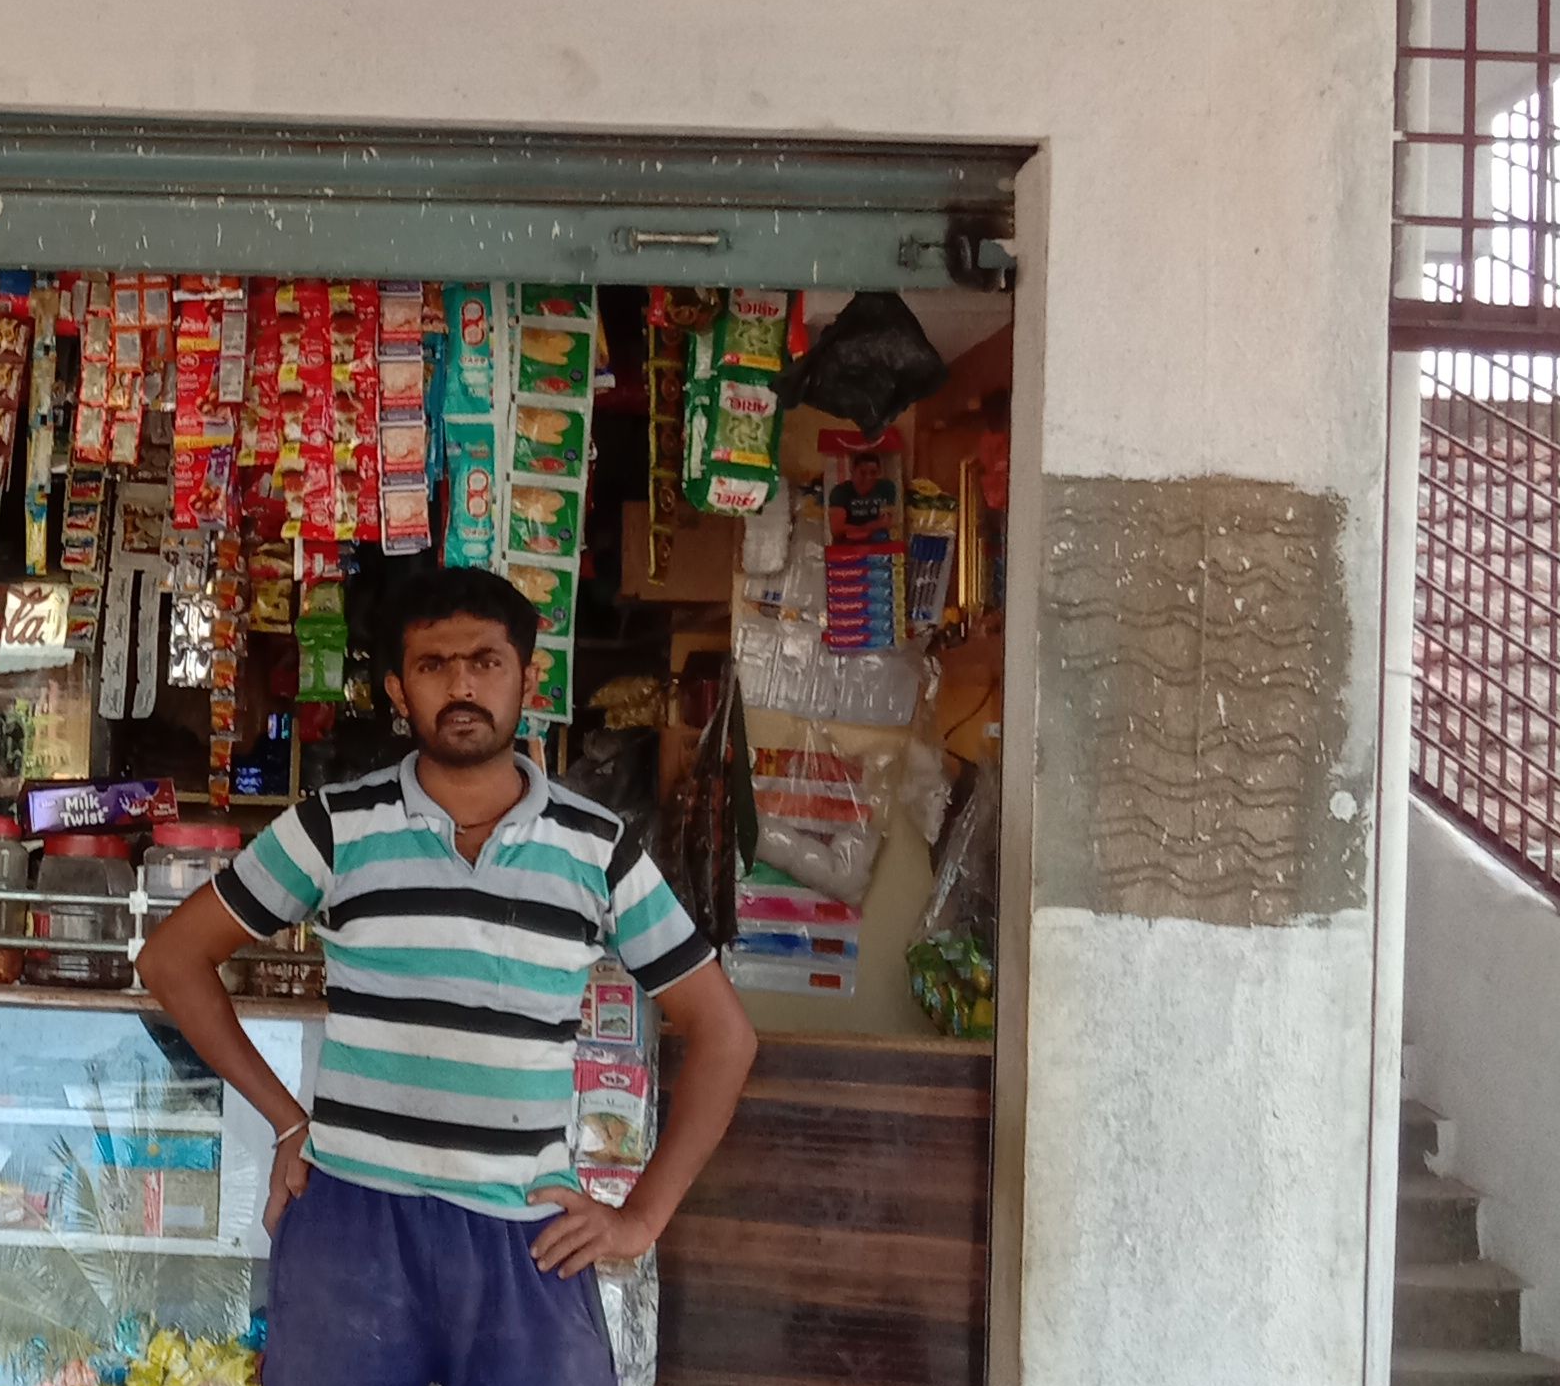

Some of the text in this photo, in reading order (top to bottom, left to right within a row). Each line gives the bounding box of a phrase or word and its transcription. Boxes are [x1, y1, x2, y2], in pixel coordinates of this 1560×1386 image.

[737, 300, 781, 318] ARIEL
[728, 397, 770, 413] ARIEL
[714, 491, 758, 508] ARIEL
[65, 793, 100, 812] Milk
[59, 810, 106, 827] Twist
